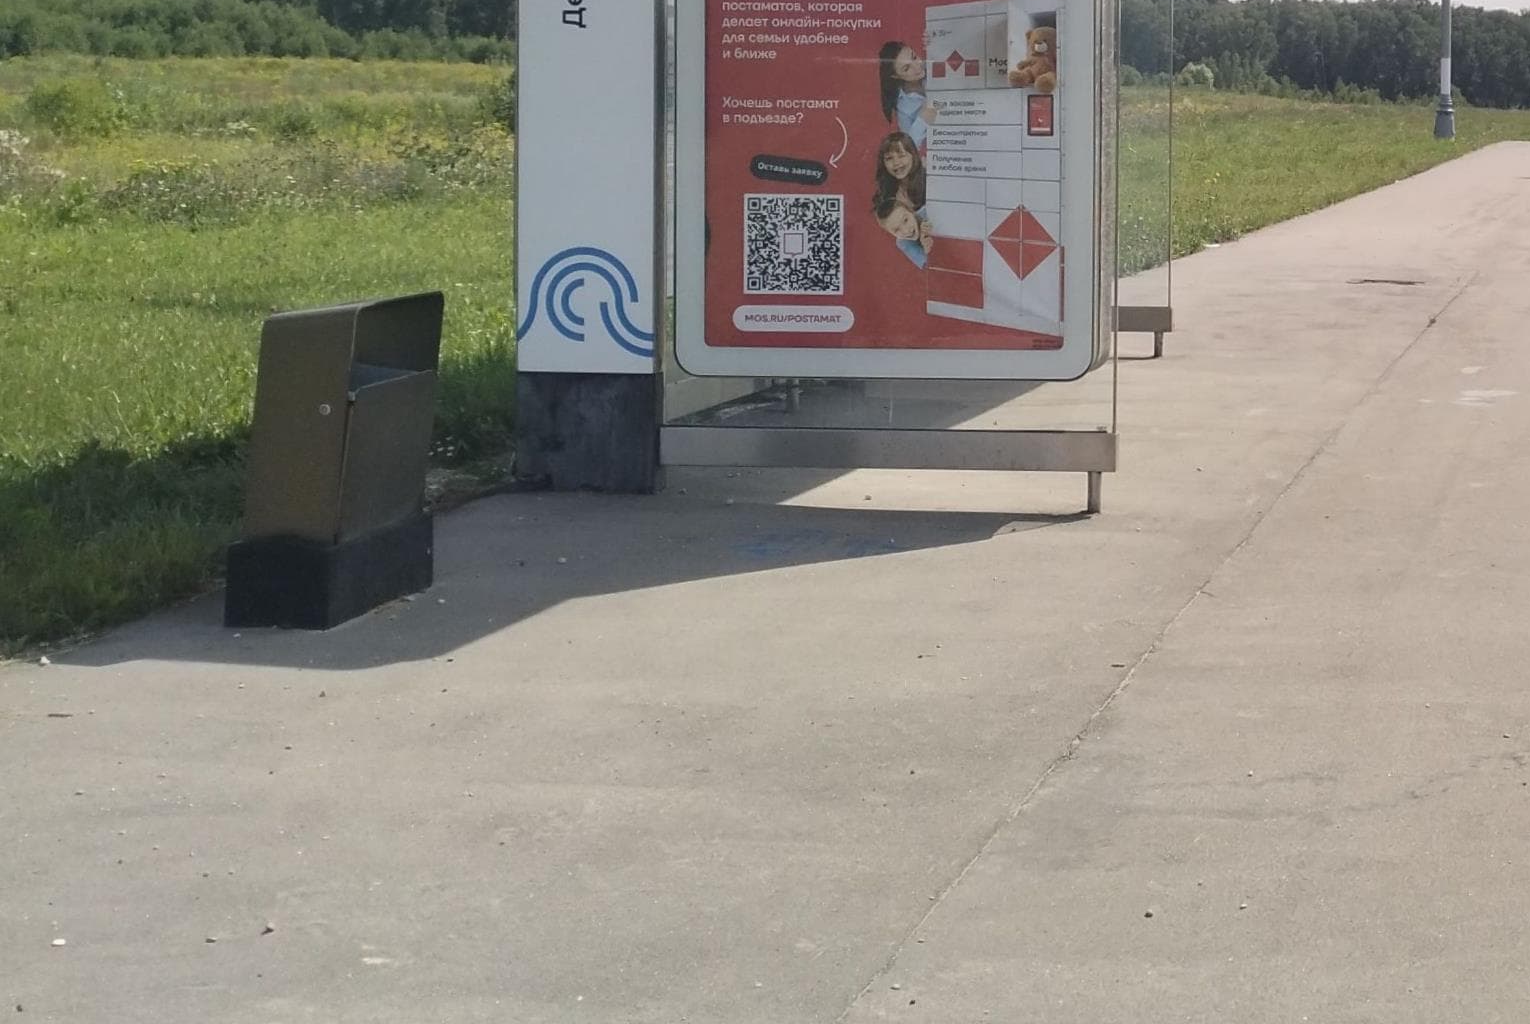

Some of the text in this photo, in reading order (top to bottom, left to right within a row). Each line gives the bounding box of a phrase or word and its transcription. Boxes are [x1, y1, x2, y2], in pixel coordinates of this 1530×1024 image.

[722, 2, 863, 14] постаматов, которая
[722, 16, 881, 31] делает онлайн-покупки
[721, 32, 849, 45] для семьи удобнее
[722, 47, 777, 59] и ближе
[722, 96, 840, 109] Хочешь постамат
[722, 112, 804, 125] в подъезде?
[932, 128, 988, 136] Бесконтактная
[757, 161, 823, 179] Оставь заявку
[744, 314, 842, 324] MOS.RU/POSTAMAT
